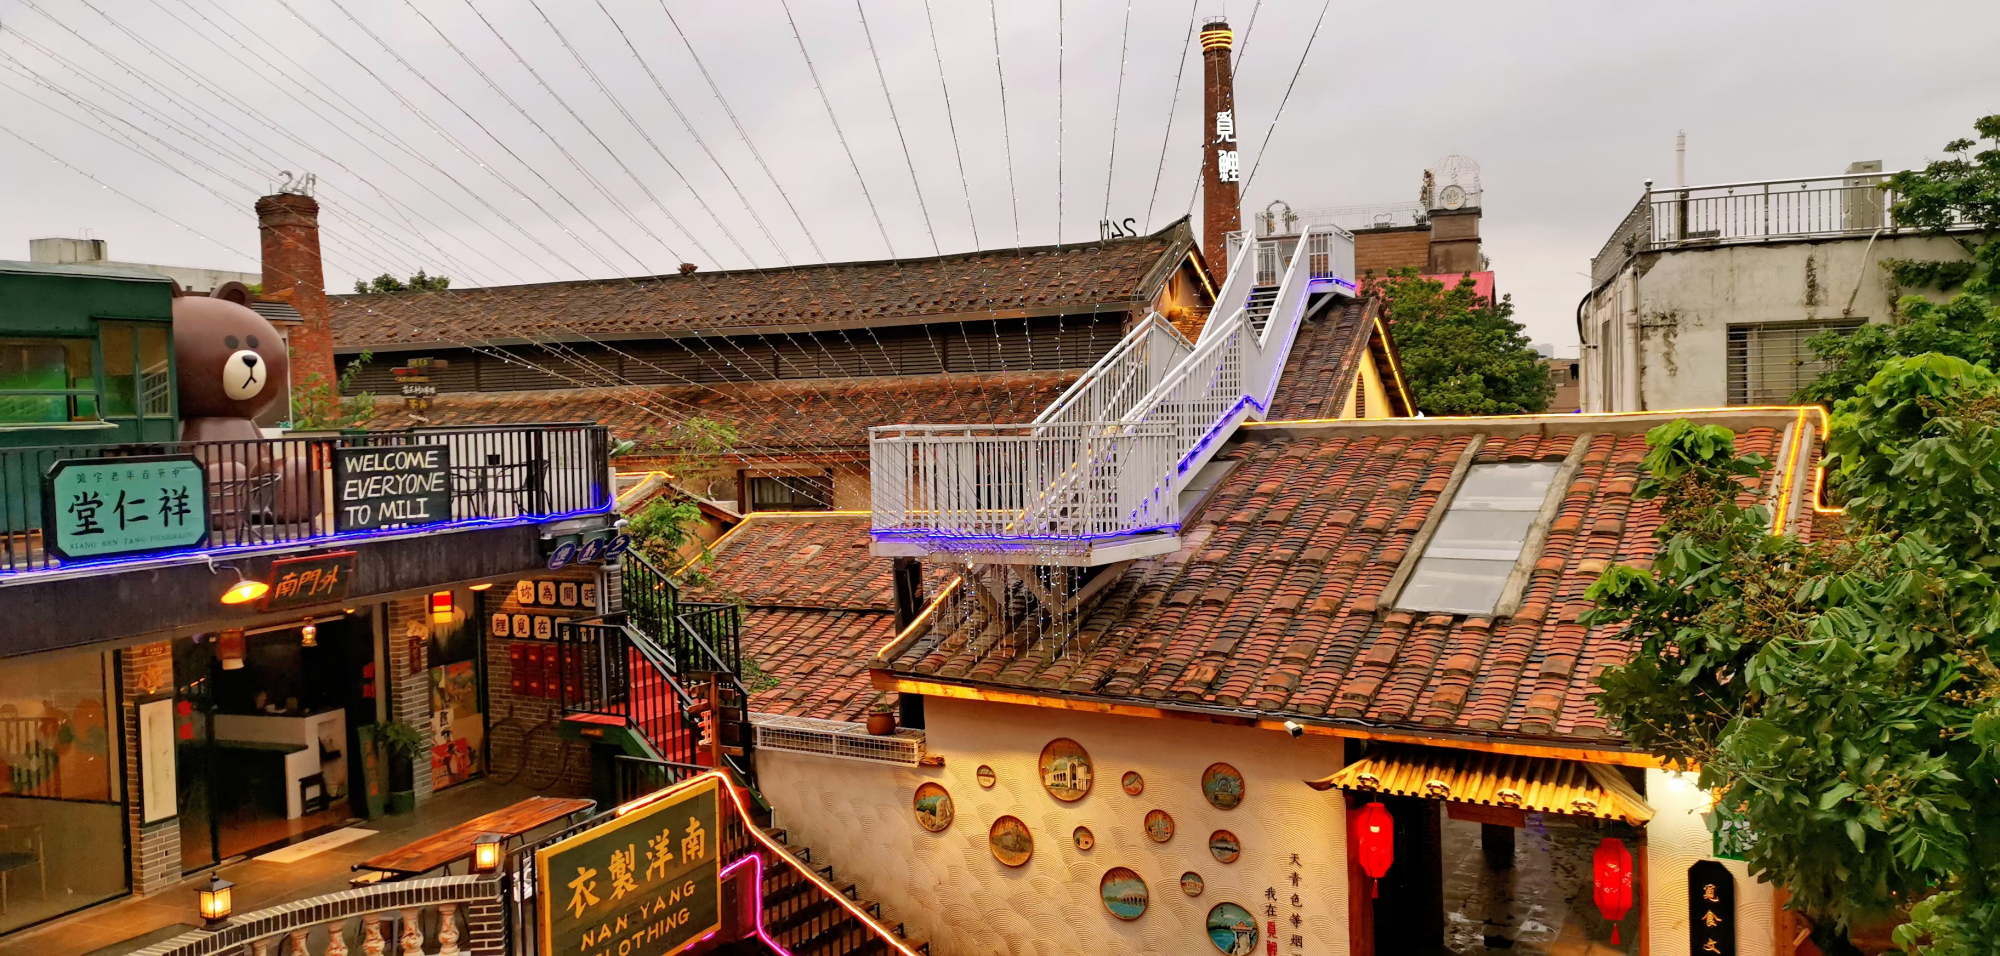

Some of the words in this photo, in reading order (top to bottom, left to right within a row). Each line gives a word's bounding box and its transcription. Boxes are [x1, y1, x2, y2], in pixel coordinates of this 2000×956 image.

[278, 170, 316, 197] 24H
[344, 450, 439, 473] WELCOME
[343, 471, 446, 501] EVERYONE
[344, 504, 371, 527] TO
[378, 497, 430, 521] MILI
[69, 541, 97, 551] XIANG
[101, 538, 118, 547] REN
[274, 564, 339, 599] 南門外
[581, 913, 629, 951] NAN
[640, 880, 696, 919] YANG
[1289, 853, 1303, 956] 天青色等烟
[596, 908, 691, 956] OTHING
